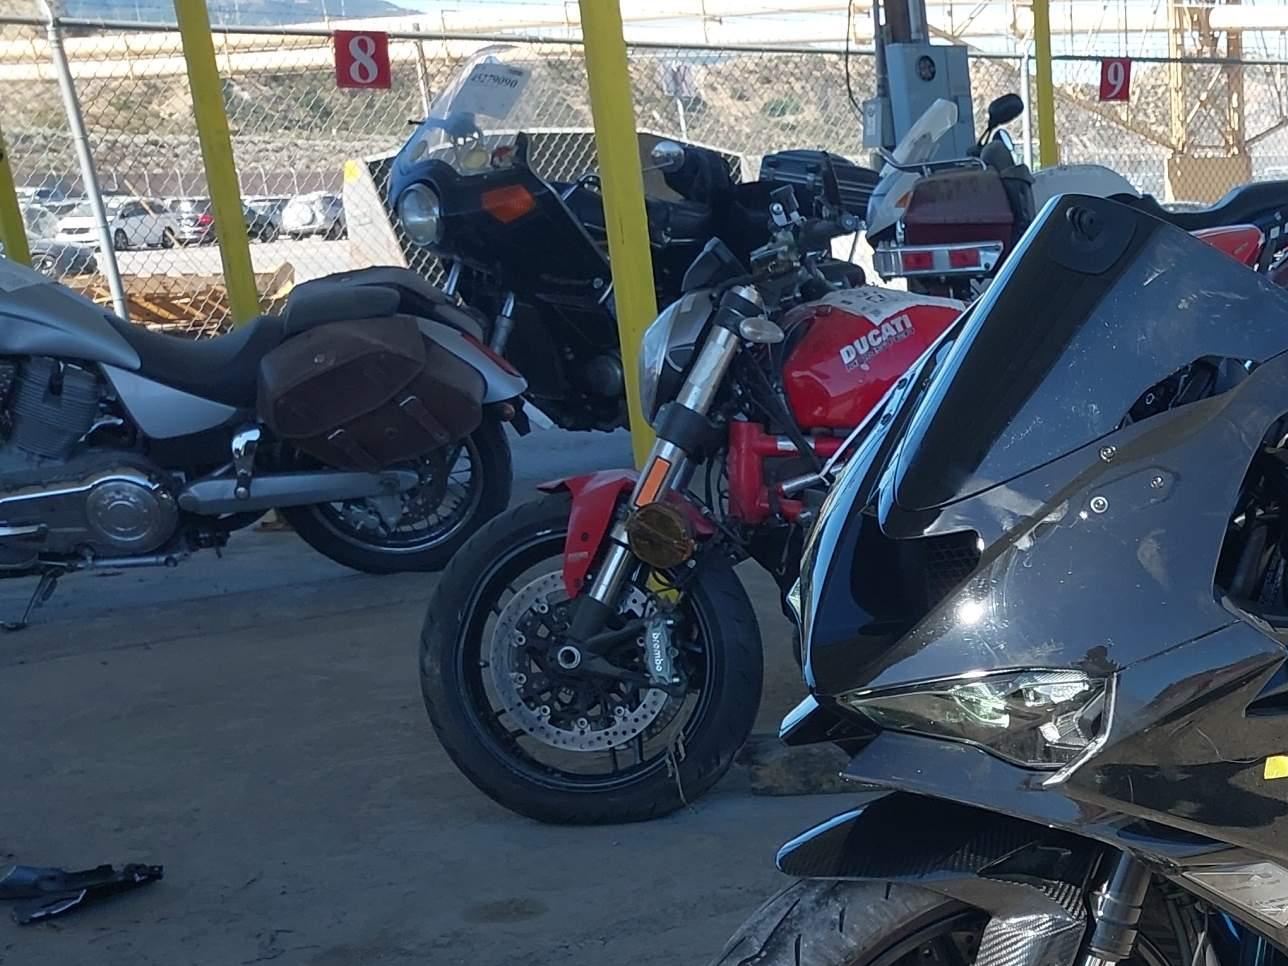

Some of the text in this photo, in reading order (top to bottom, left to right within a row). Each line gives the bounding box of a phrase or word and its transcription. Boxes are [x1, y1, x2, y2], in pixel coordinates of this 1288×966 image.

[349, 35, 378, 84] 8
[1106, 62, 1125, 98] 9
[839, 314, 913, 365] DUCATI
[652, 632, 664, 672] brembo
